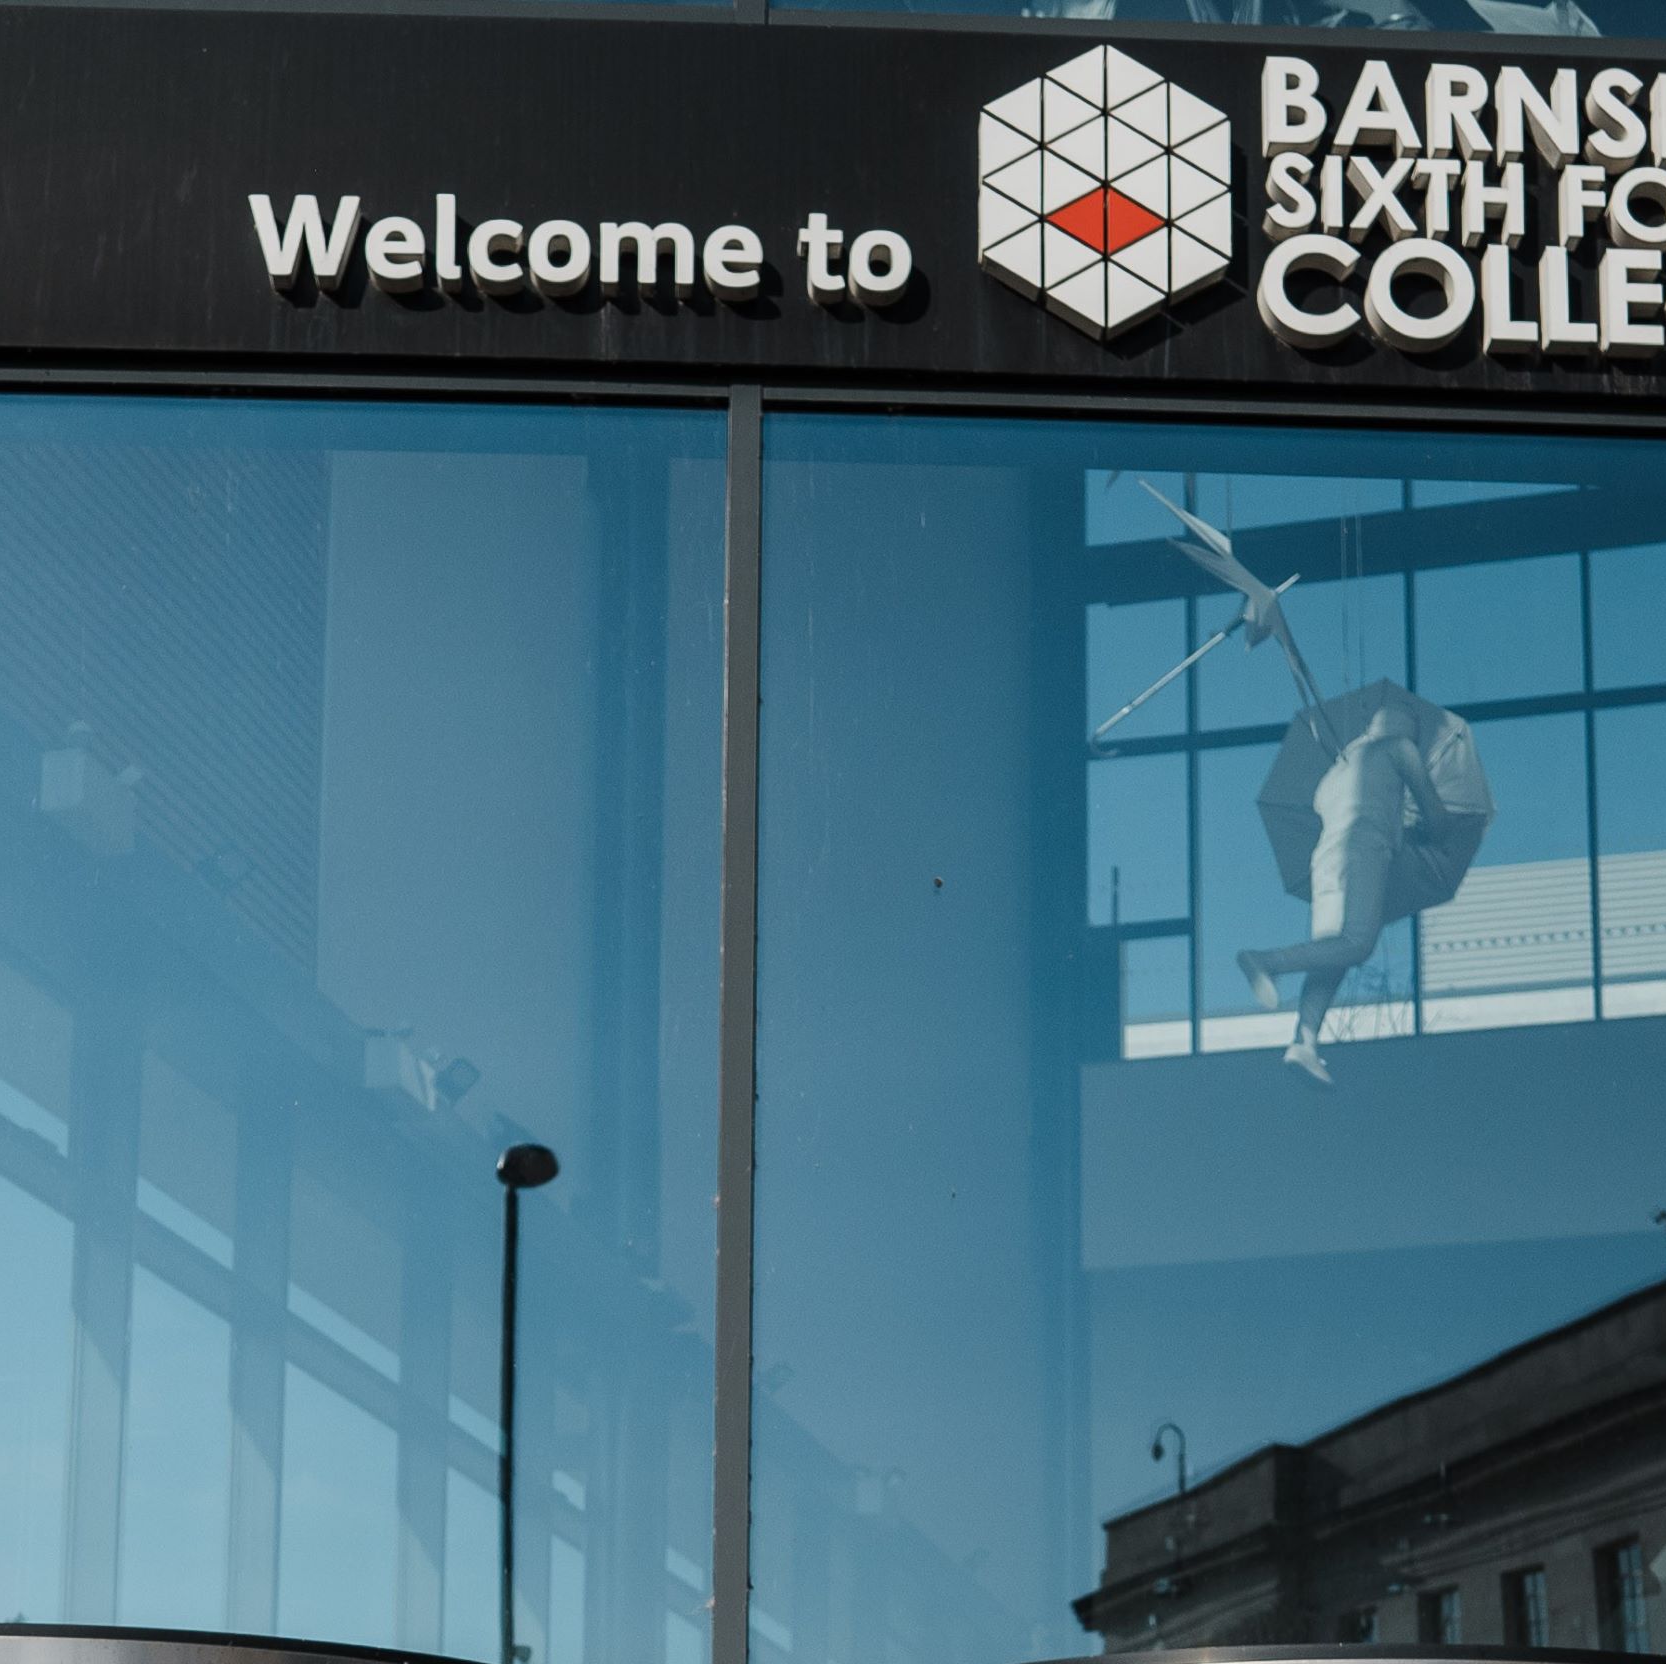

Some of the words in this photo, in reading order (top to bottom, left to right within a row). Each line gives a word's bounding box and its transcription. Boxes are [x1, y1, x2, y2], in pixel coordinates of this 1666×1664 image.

[247, 192, 765, 300] Welcome
[796, 212, 913, 306] to
[1263, 152, 1527, 249] SIXTH
